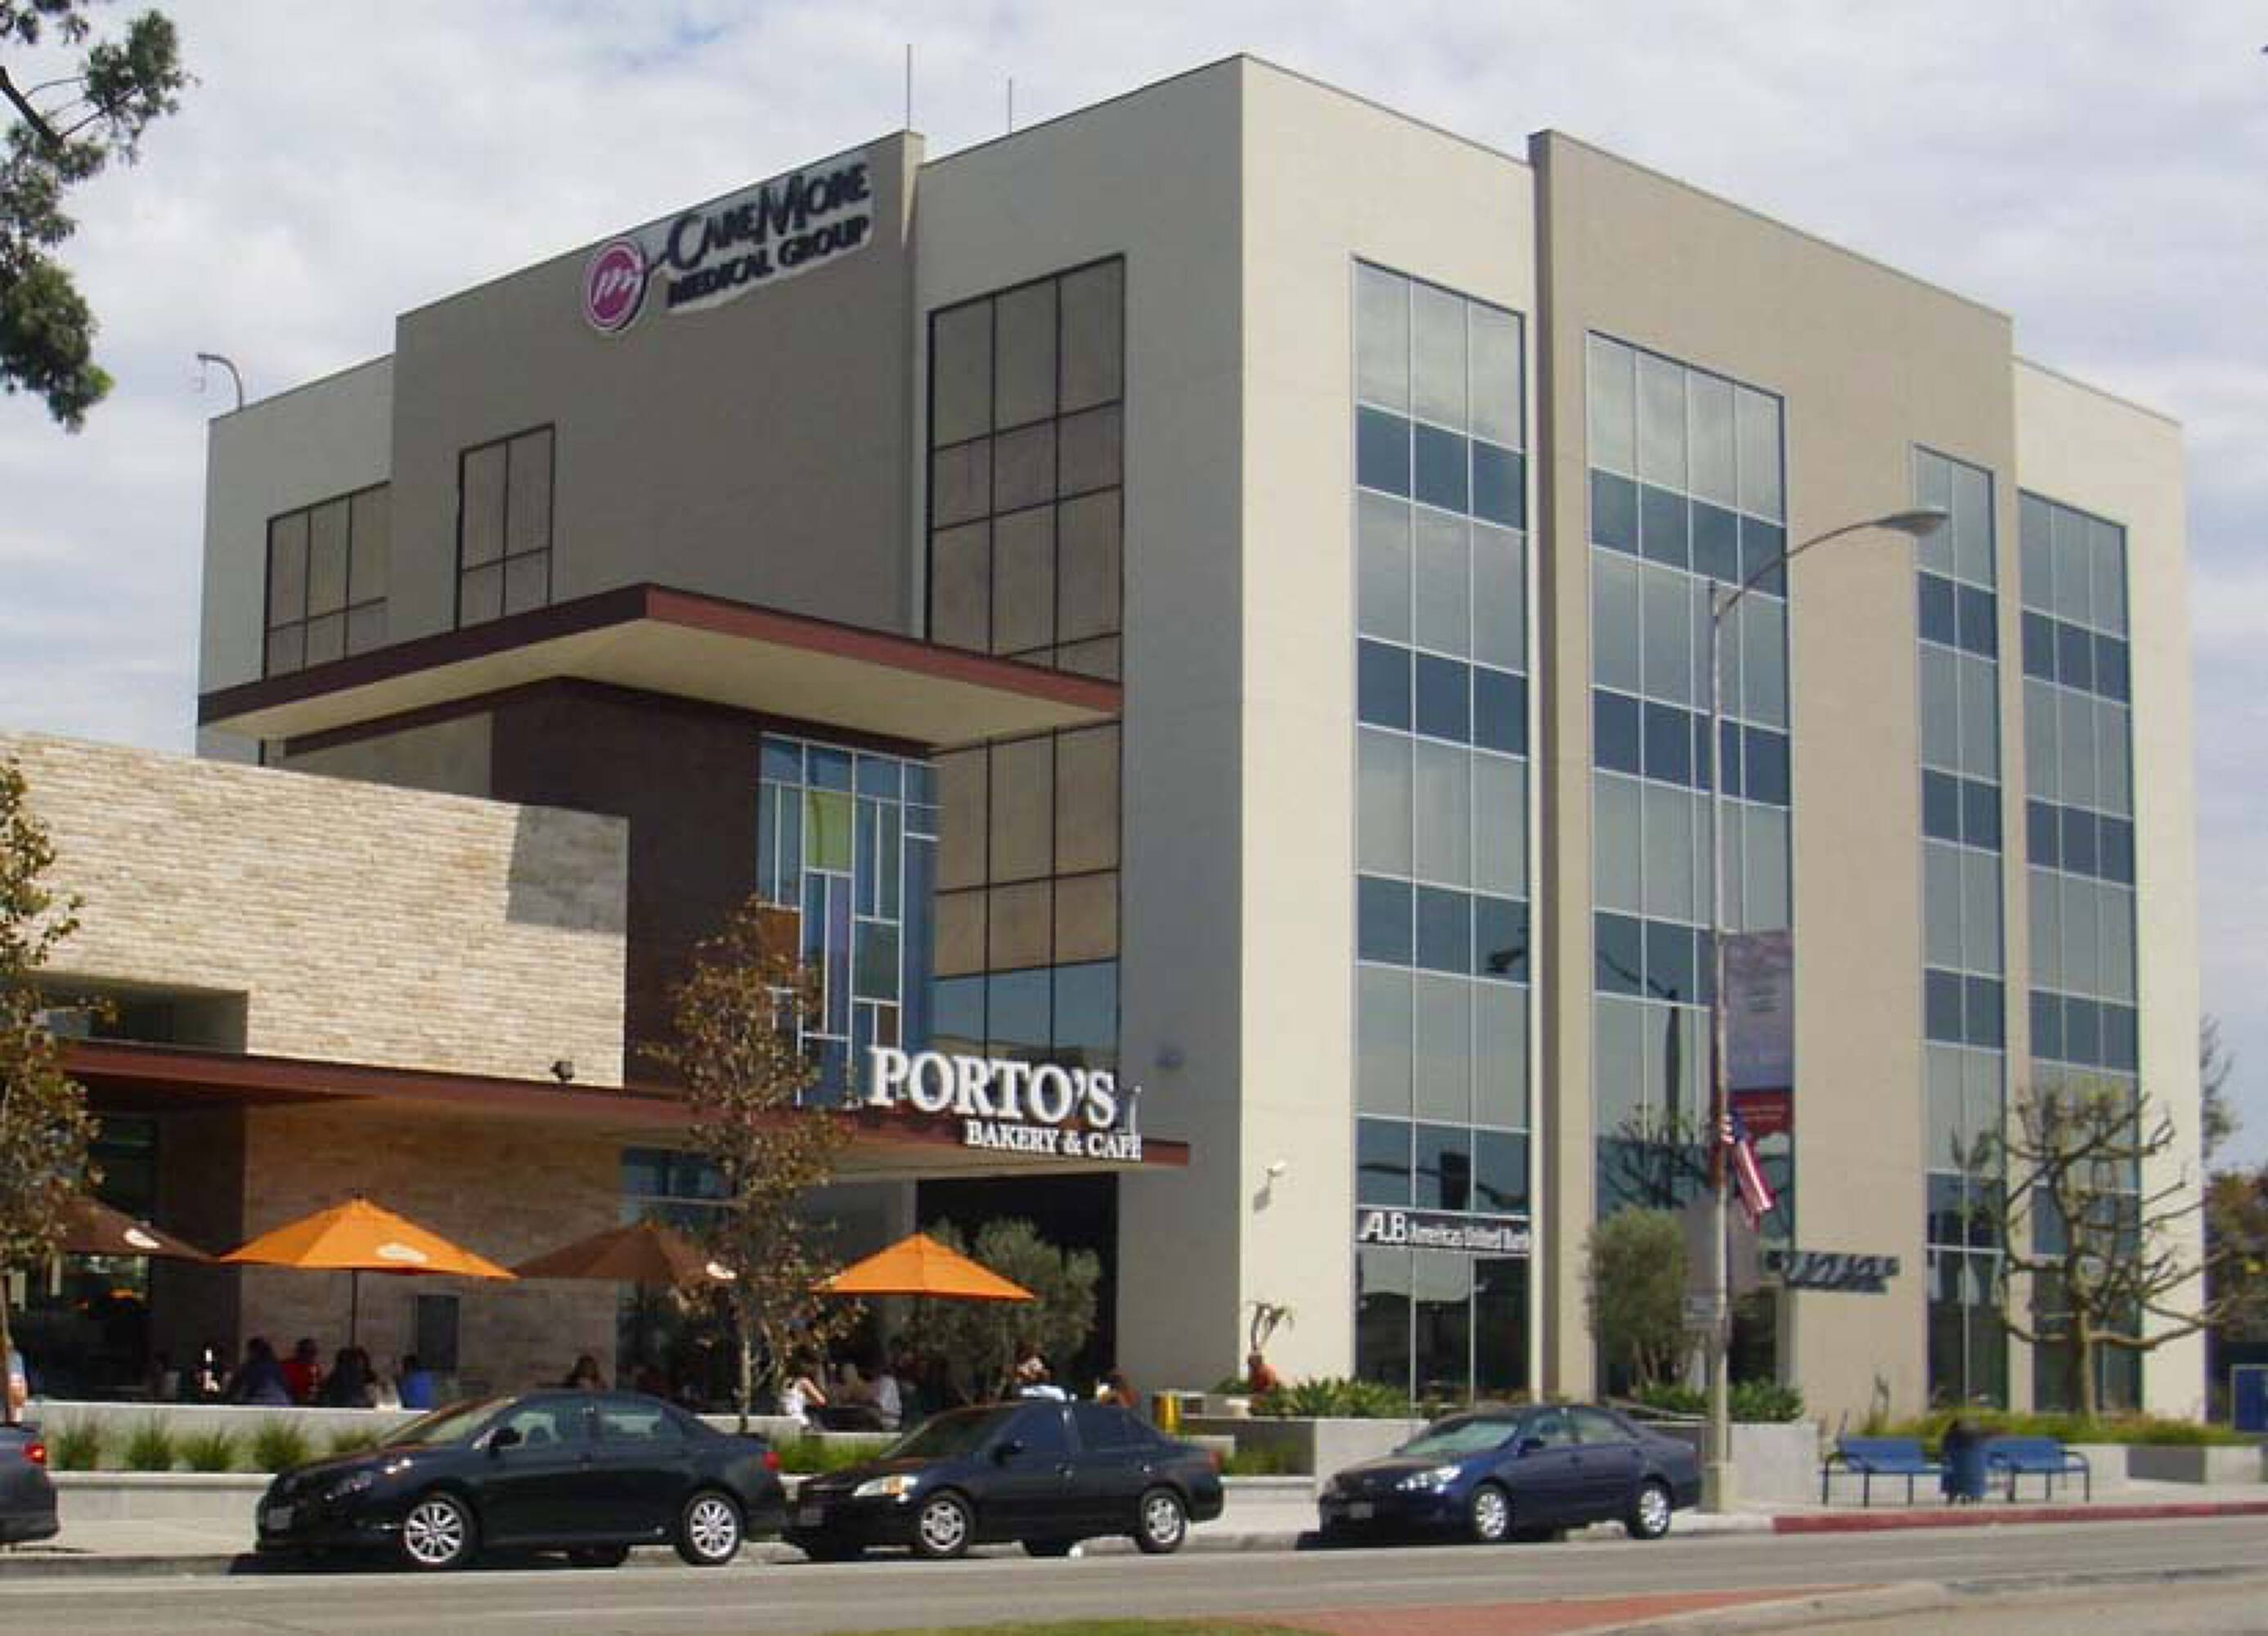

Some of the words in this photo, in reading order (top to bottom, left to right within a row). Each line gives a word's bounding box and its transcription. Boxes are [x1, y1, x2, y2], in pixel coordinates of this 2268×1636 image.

[778, 216, 869, 267] GROUP
[868, 1046, 1116, 1128] PORTO'S
[966, 1118, 1060, 1154] BAKERY
[1062, 1130, 1084, 1156] &
